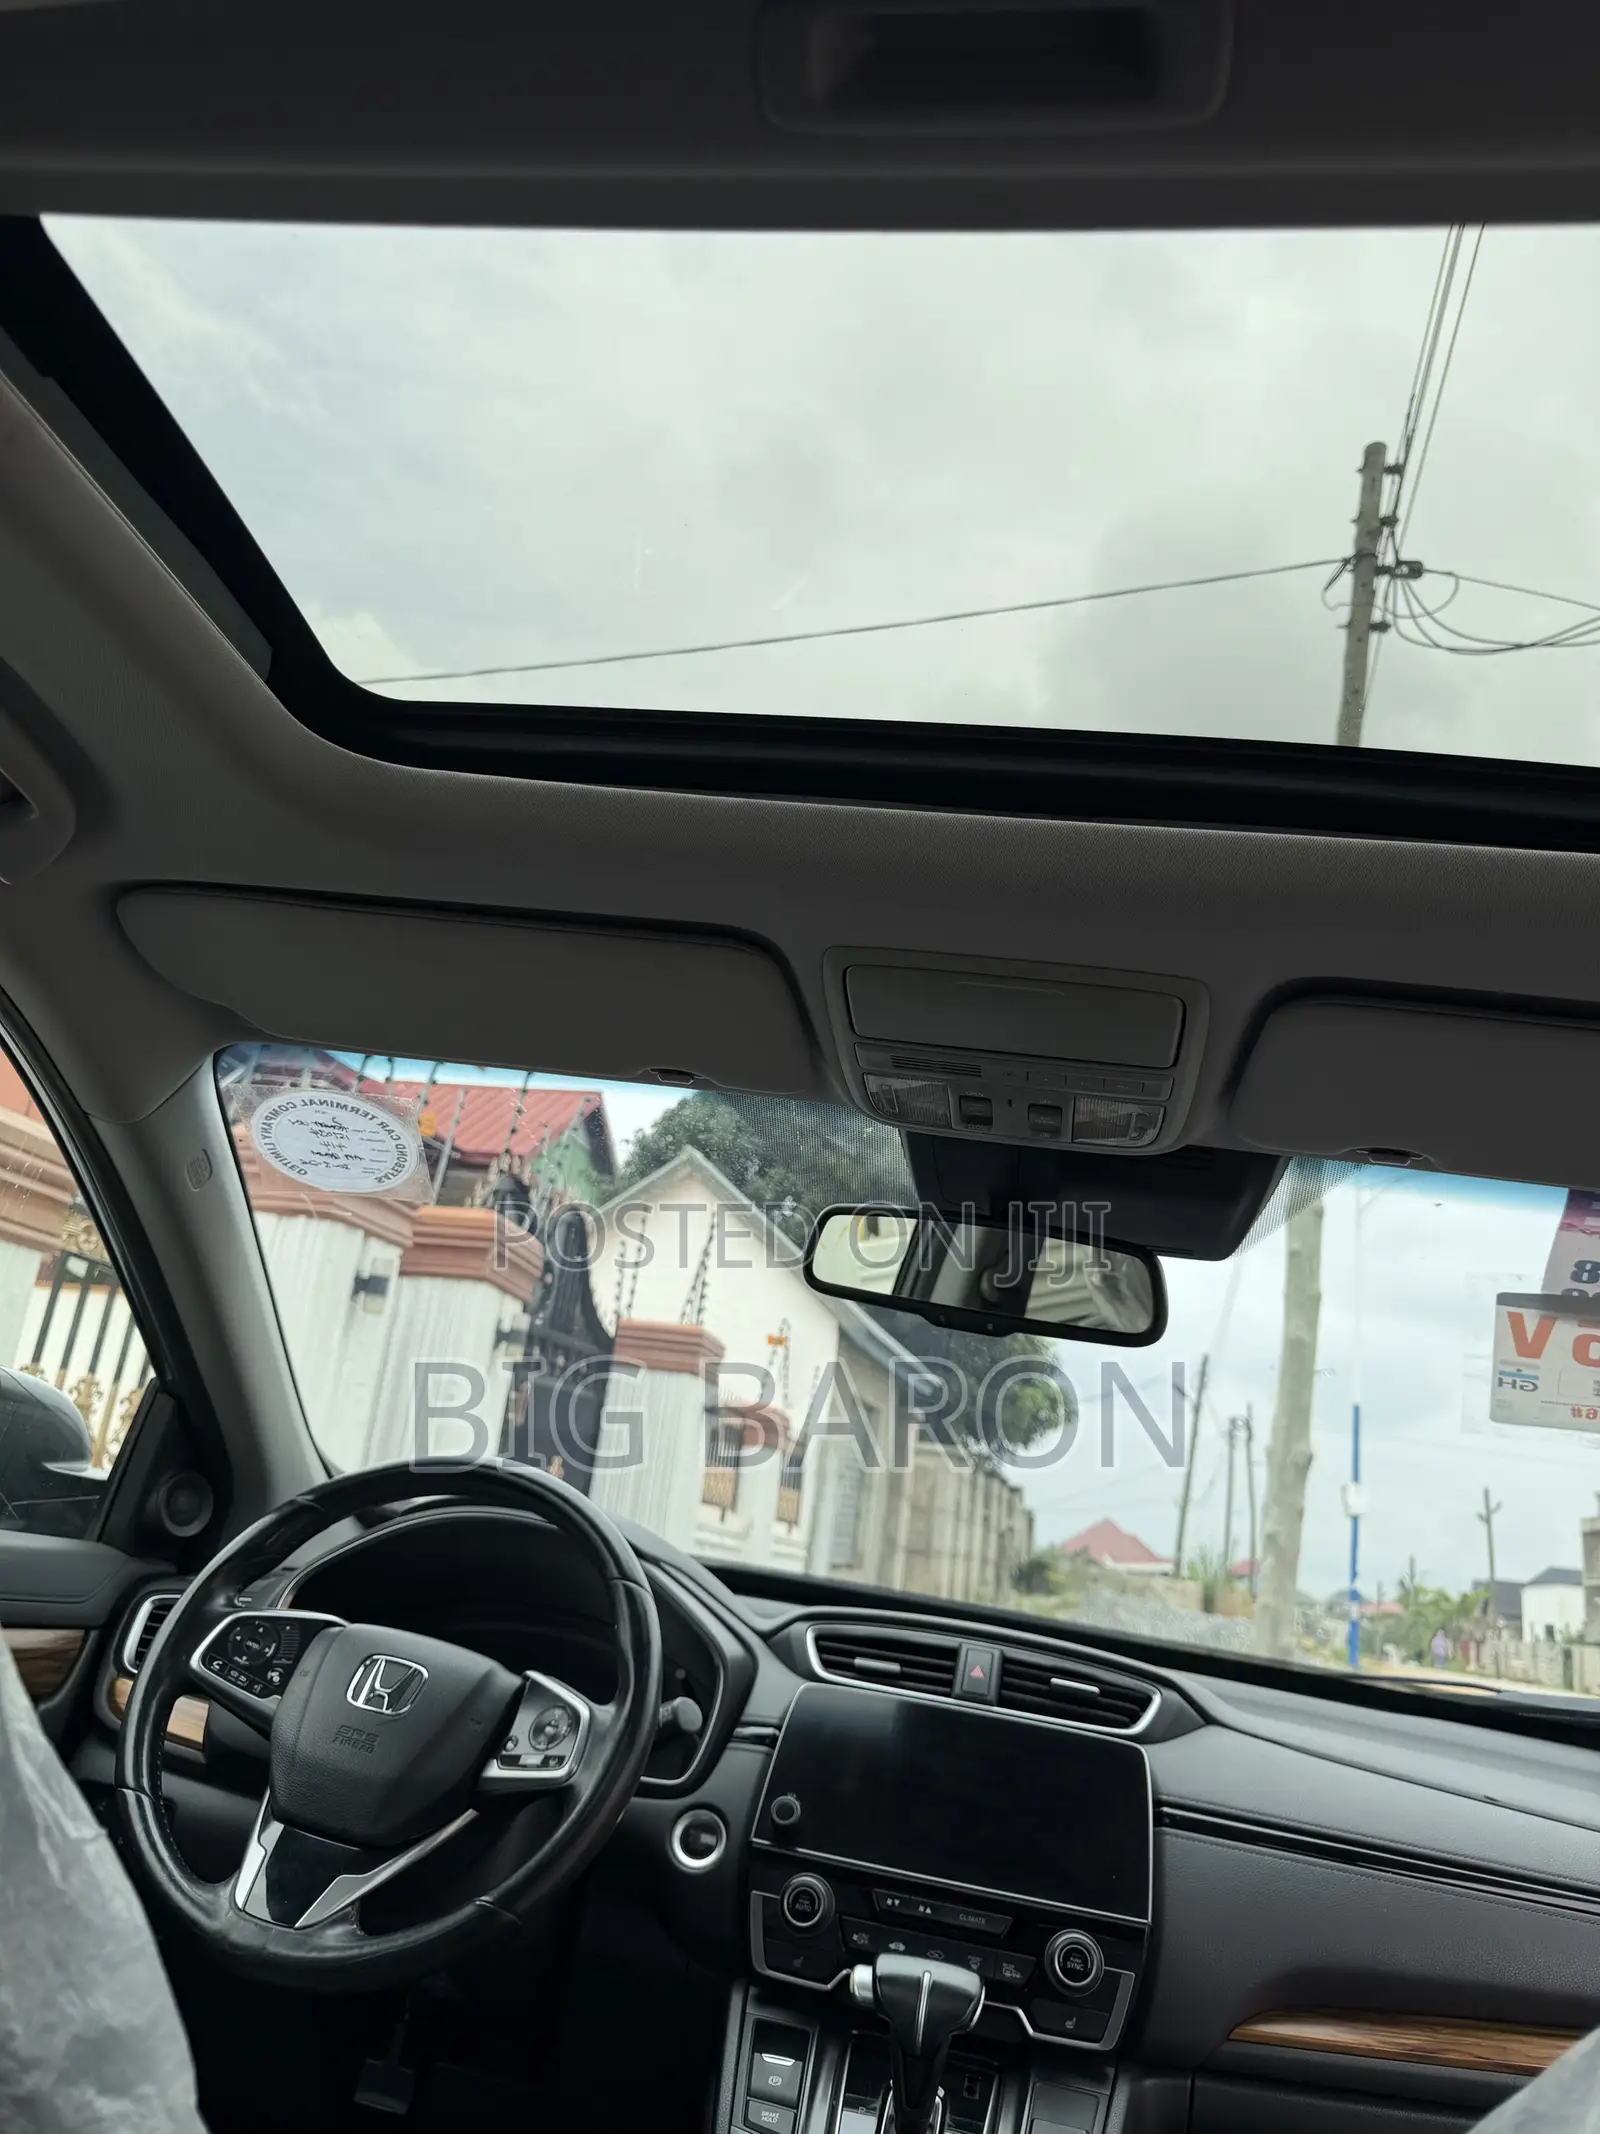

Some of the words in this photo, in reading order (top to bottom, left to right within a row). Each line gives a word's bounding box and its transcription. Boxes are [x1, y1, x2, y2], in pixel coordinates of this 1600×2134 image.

[958, 1913, 987, 1926] CLIMATE
[1066, 1961, 1085, 1971] SYNC
[761, 2110, 780, 2118] BRAKE
[761, 2116, 778, 2124] HOLD
